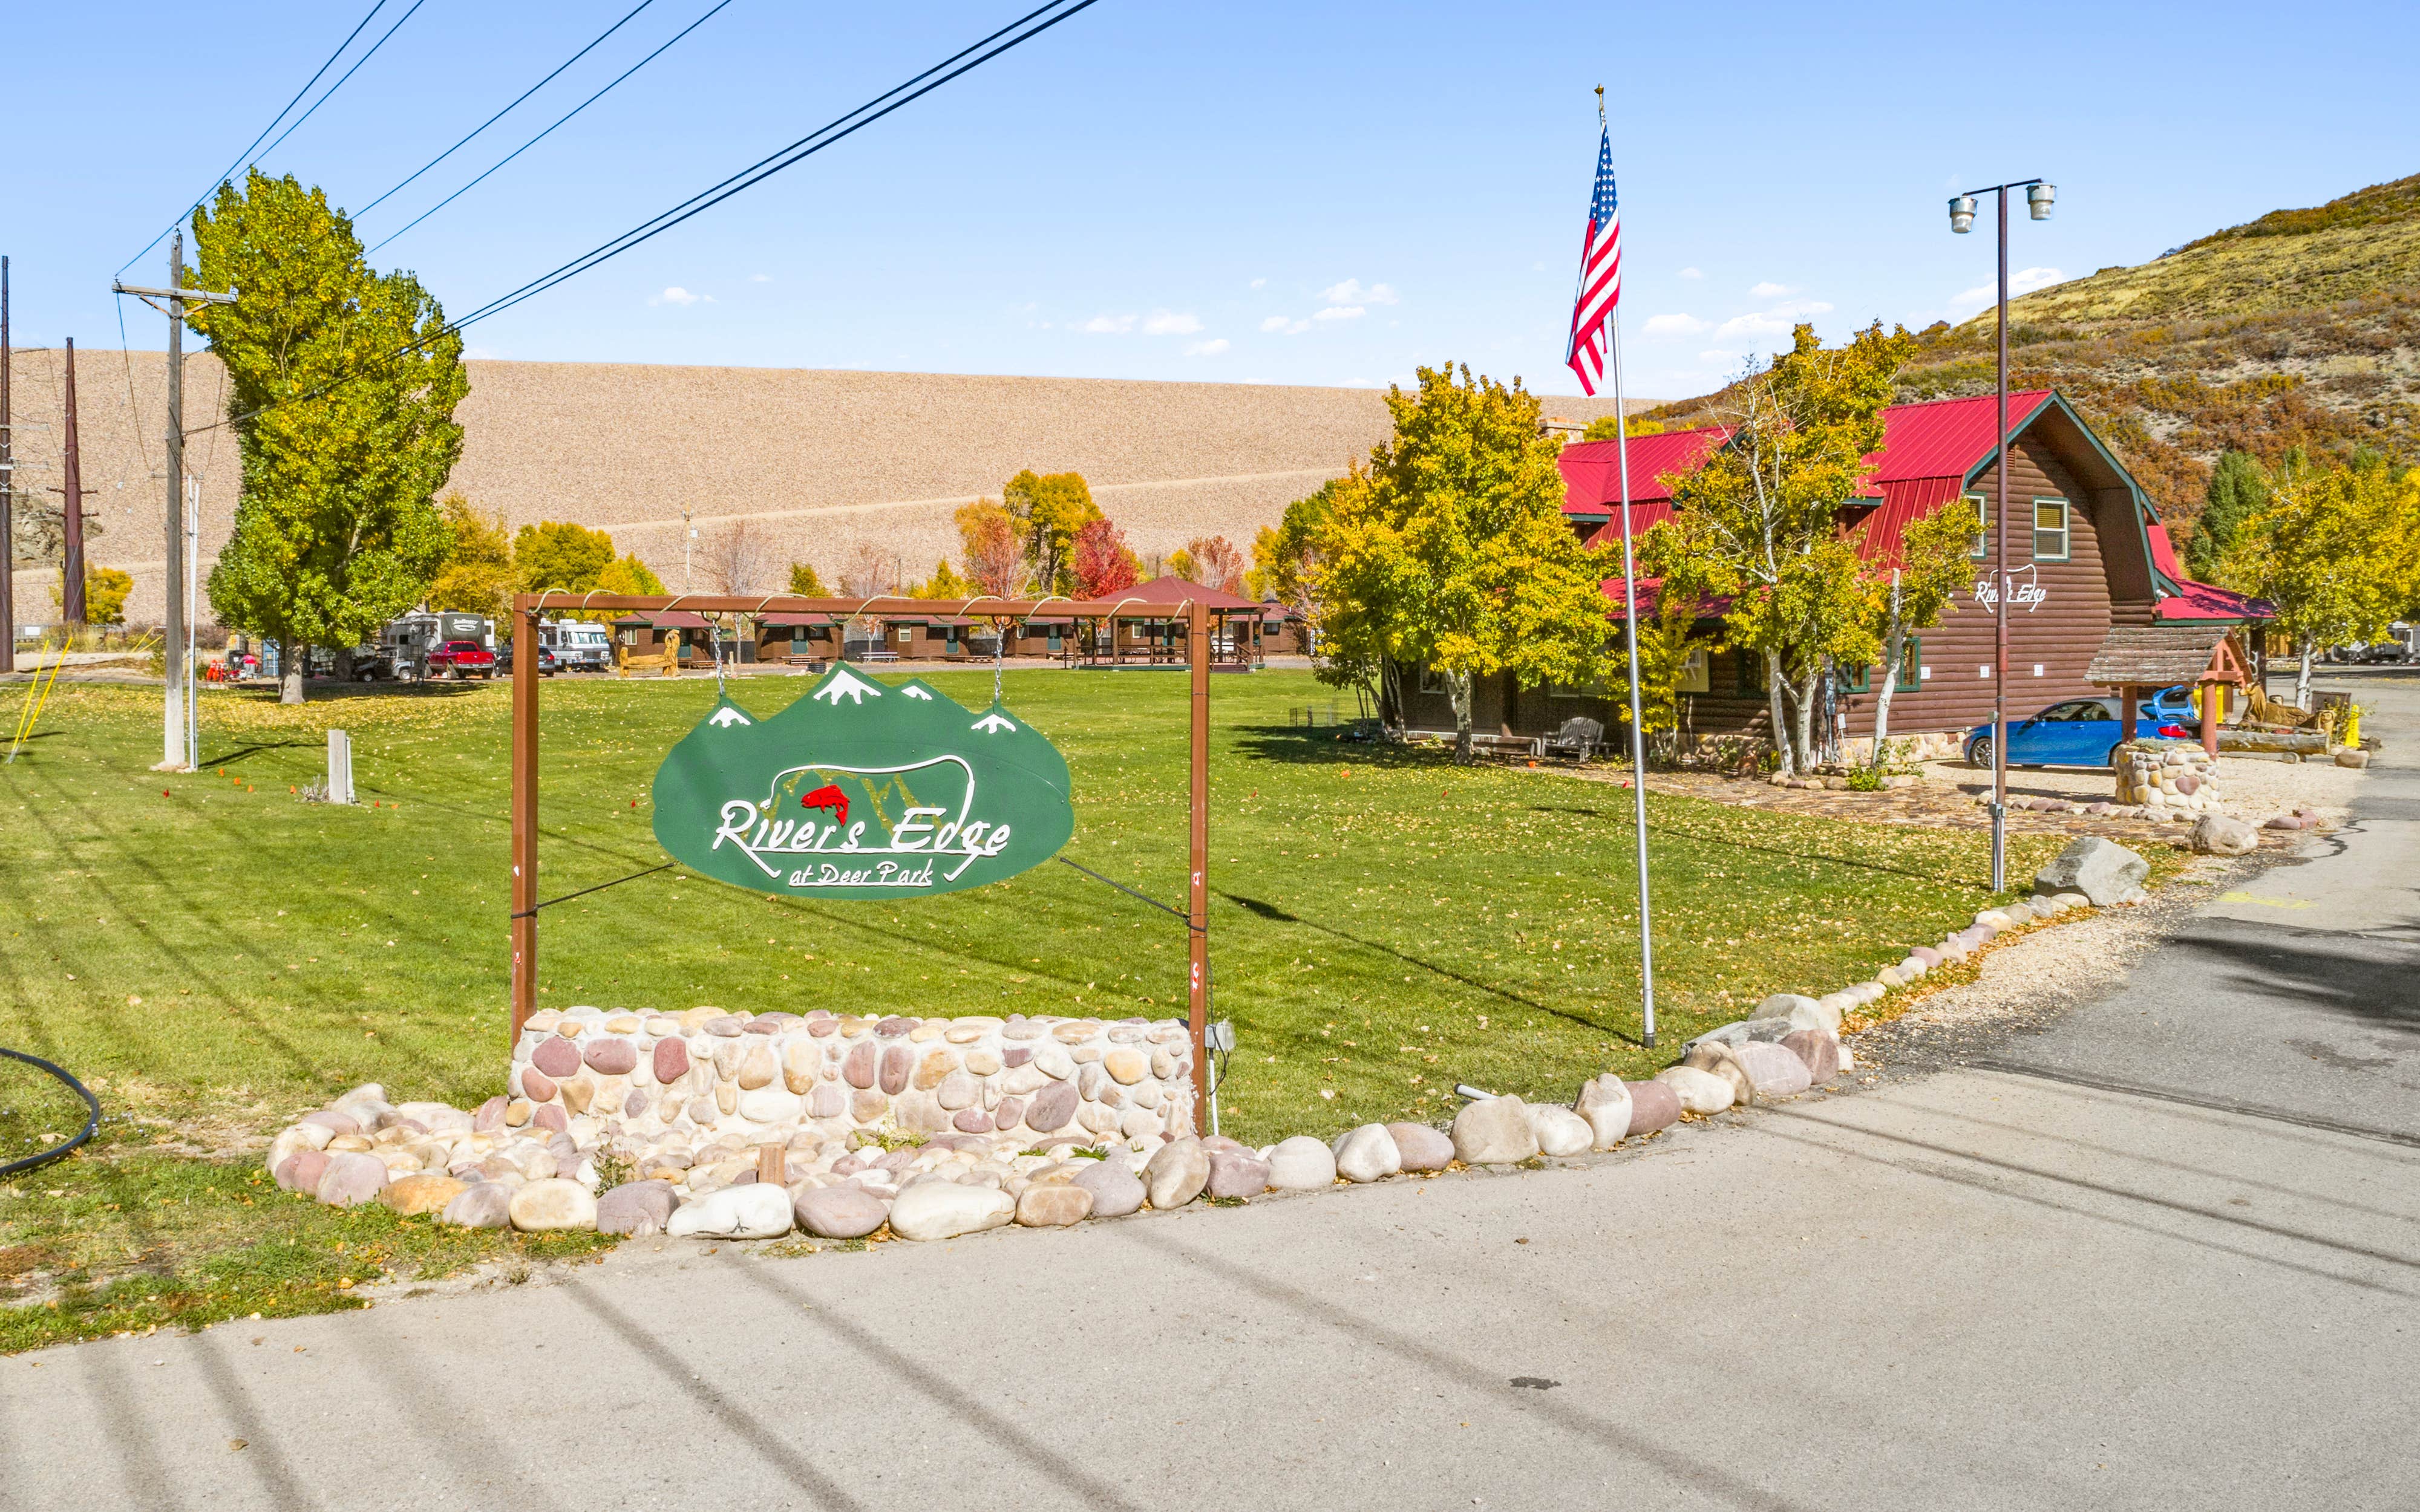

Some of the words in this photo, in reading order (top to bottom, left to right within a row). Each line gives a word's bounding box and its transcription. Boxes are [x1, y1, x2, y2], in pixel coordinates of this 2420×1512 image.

[2016, 584, 2047, 613] Edge
[891, 807, 1010, 882] Edge
[789, 864, 814, 883] at
[818, 863, 872, 883] Deer
[876, 858, 934, 883] Park
